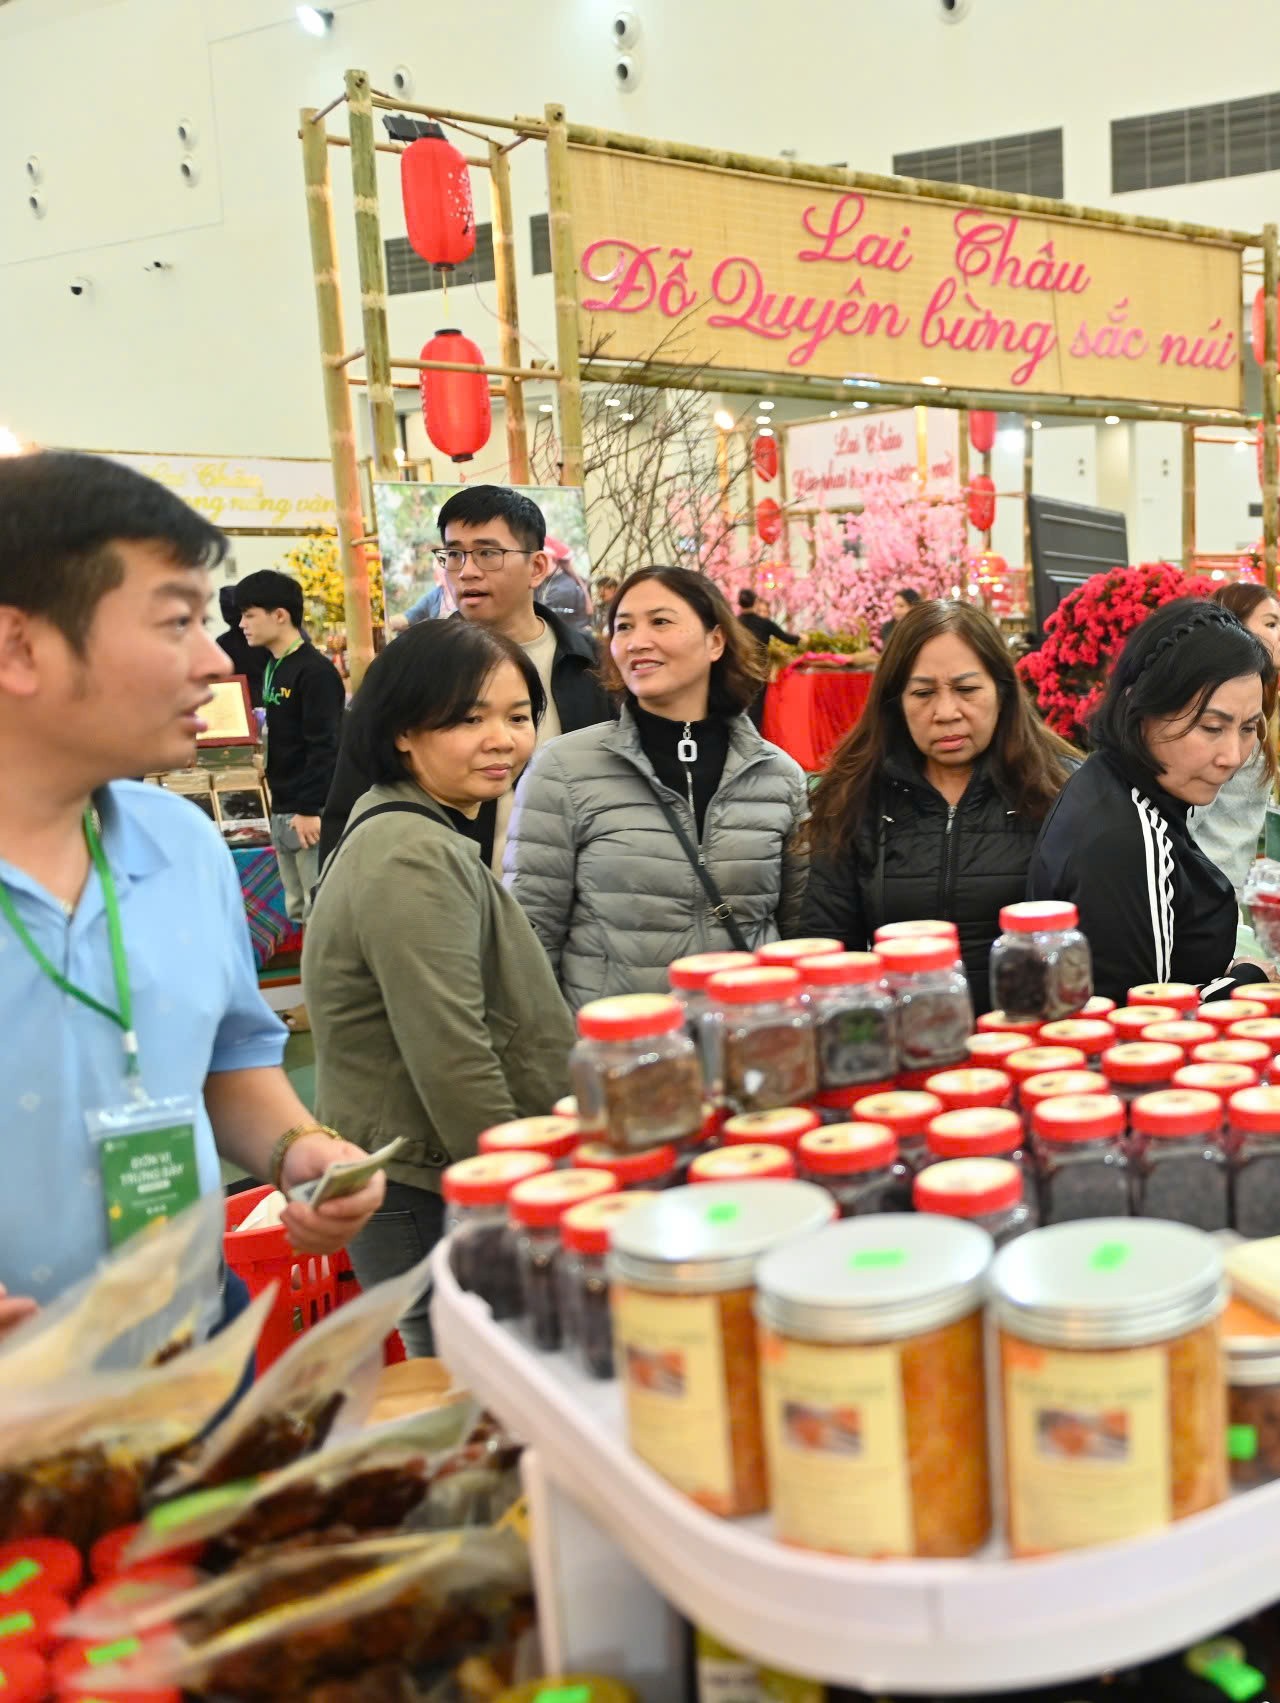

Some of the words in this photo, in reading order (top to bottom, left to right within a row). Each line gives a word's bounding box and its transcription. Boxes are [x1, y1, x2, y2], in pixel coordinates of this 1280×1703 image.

[798, 193, 914, 274] Lai
[954, 208, 1092, 296] Châu
[580, 239, 697, 317] Đỗ
[708, 256, 907, 366] Quyên
[920, 277, 1058, 386] bừng
[1068, 296, 1150, 360] sắc
[1159, 318, 1238, 371] núi
